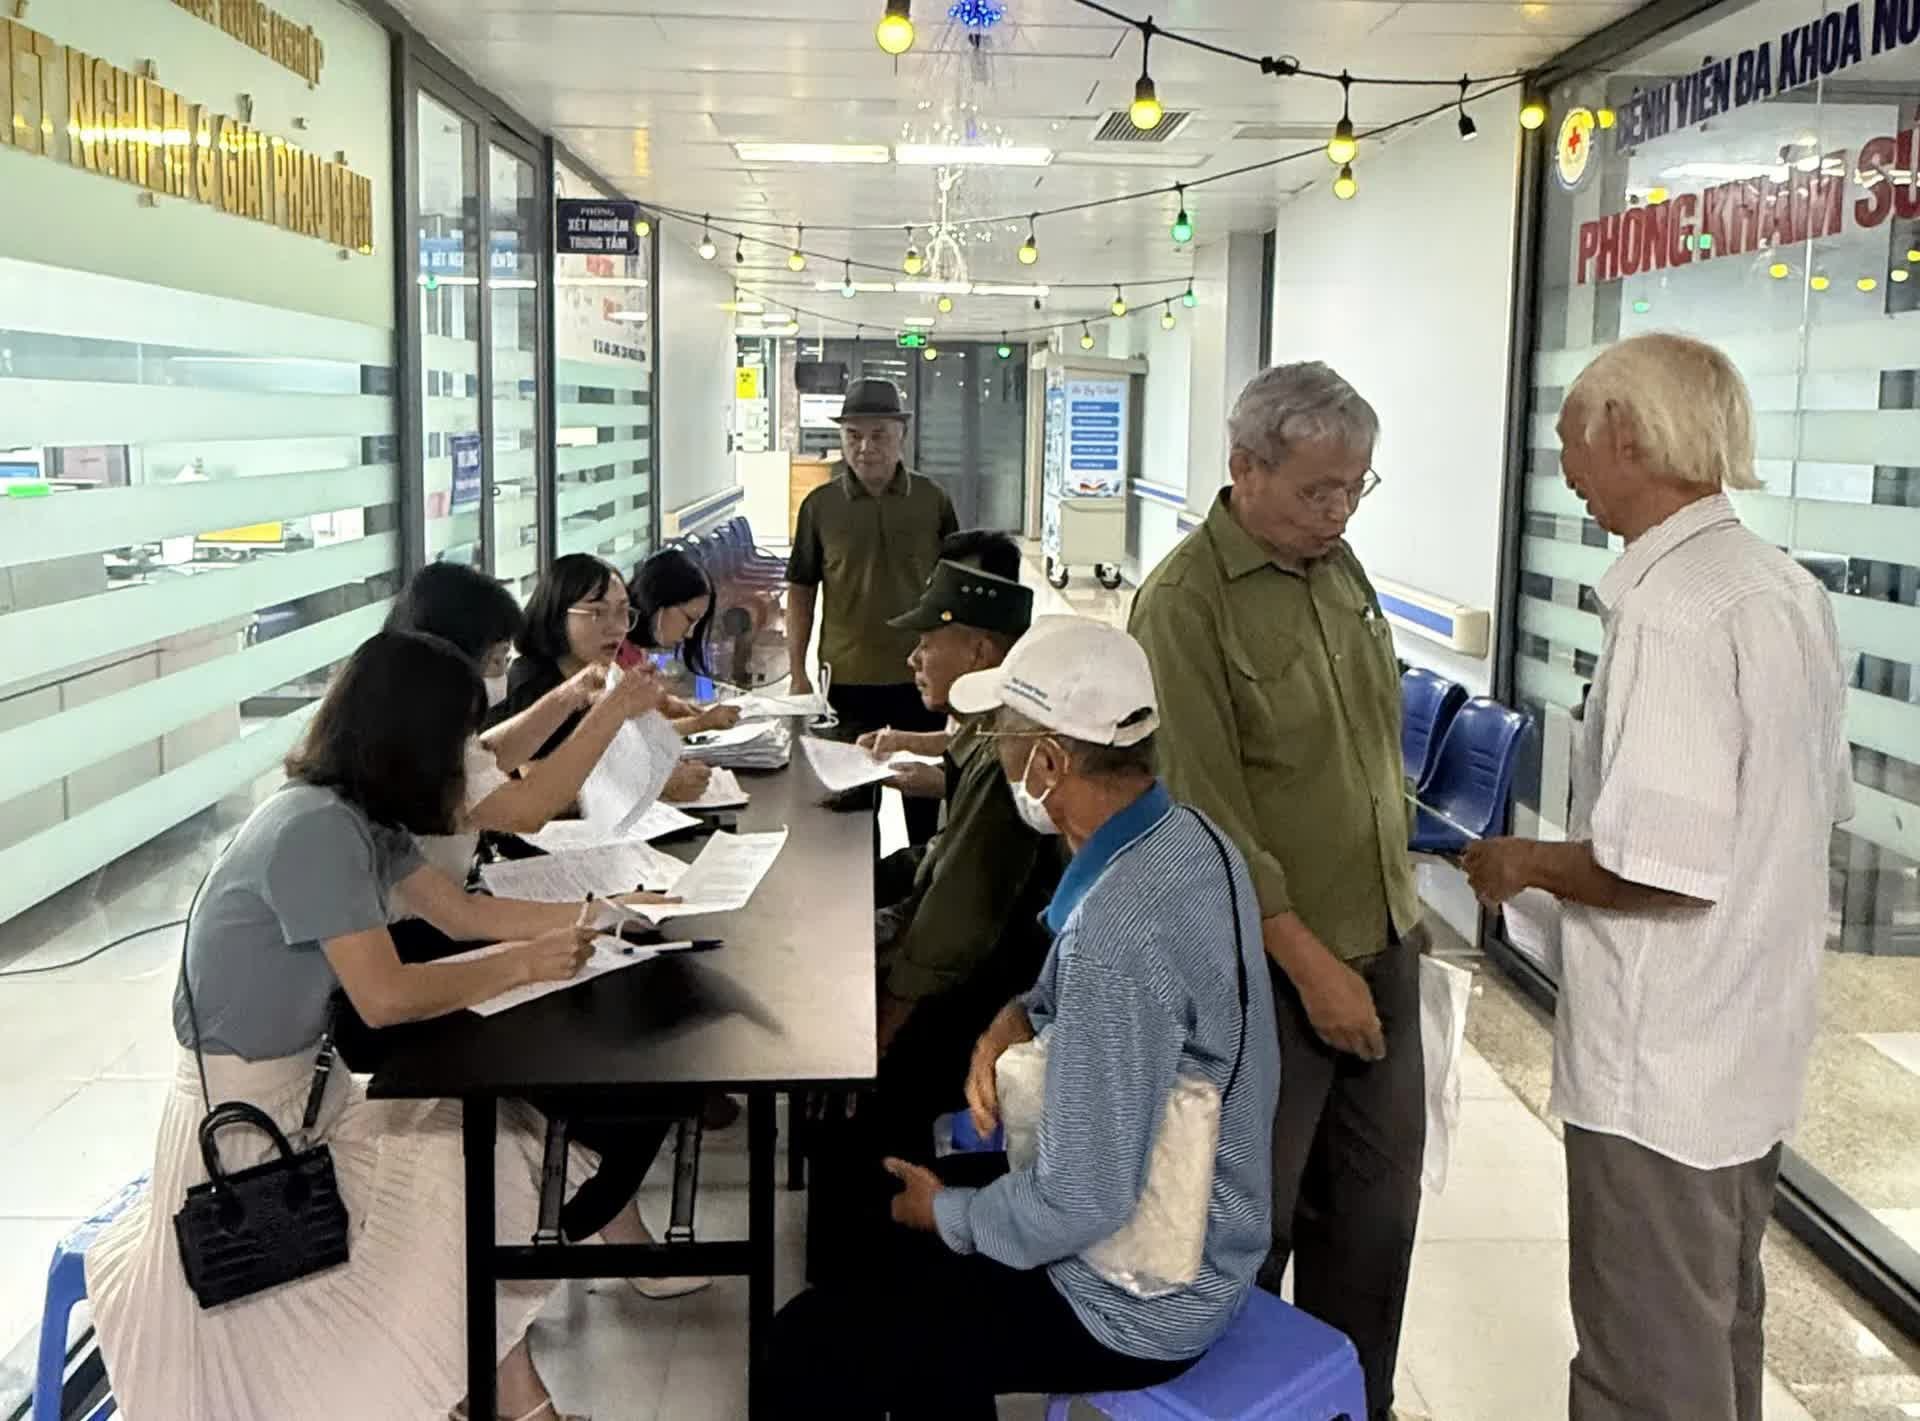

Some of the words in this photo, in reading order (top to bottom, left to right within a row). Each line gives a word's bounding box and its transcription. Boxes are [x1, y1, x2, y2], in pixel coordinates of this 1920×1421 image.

[0, 0, 58, 157] ÉT
[65, 44, 190, 208] NGHIỆM
[195, 103, 215, 205] &
[1675, 55, 1732, 133] VIỆN
[1779, 3, 1863, 92] KHOA
